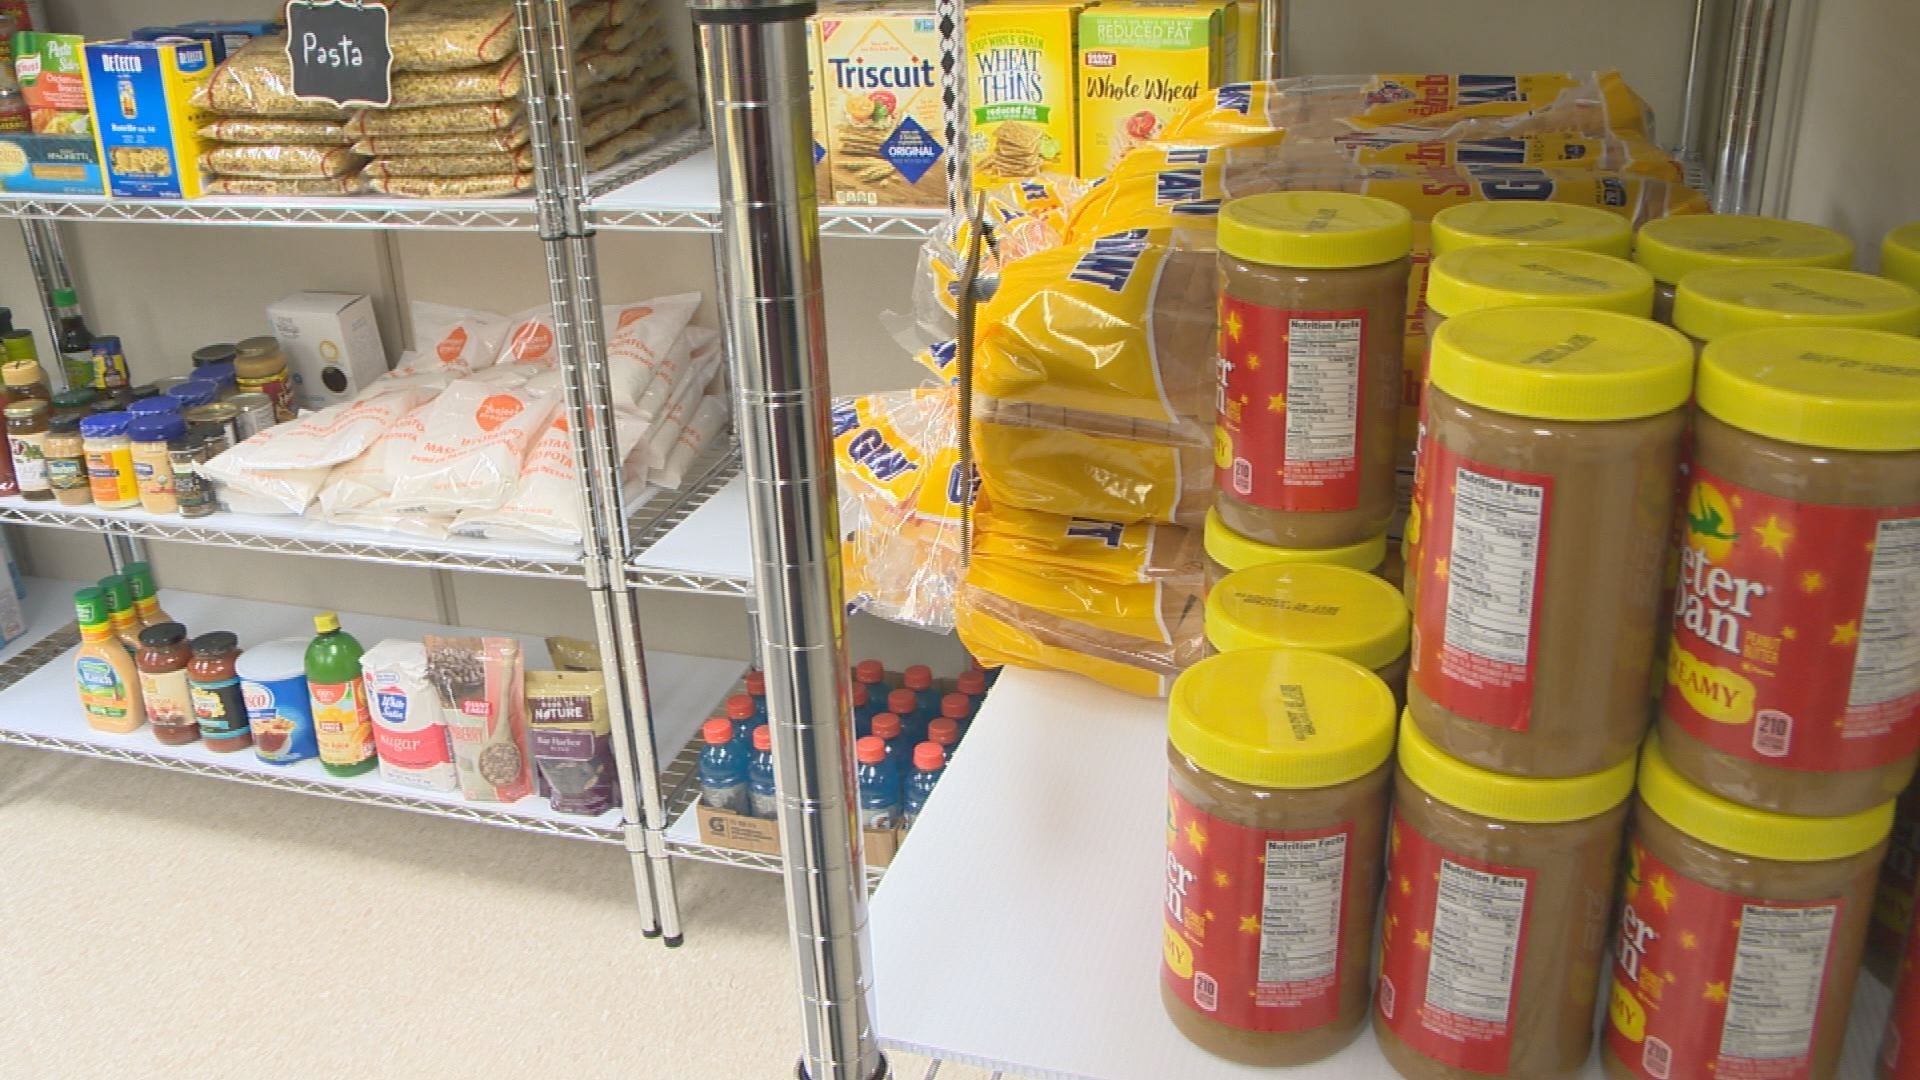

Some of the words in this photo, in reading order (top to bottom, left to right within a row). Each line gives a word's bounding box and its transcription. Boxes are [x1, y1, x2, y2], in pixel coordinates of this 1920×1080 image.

[1097, 24, 1163, 39] REDUCED
[1167, 25, 1193, 40] FAT
[303, 32, 363, 67] Pasta
[976, 48, 1042, 73] WHEAT
[828, 58, 935, 88] Triscuit
[1087, 73, 1140, 101] Whole
[1145, 78, 1200, 103] Wheat
[888, 146, 935, 157] ORIGINAL
[1292, 321, 1333, 330] Nutrition
[1335, 320, 1360, 329] Facts
[1458, 470, 1503, 491] Nutrition
[1505, 483, 1540, 498] Facts
[1759, 715, 1788, 736] 210
[381, 736, 421, 752] sugar
[1268, 842, 1316, 851] Nutrition
[1319, 836, 1345, 847] Facts
[1443, 861, 1490, 883] Nutrition
[1492, 876, 1525, 888] Facts
[1746, 906, 1800, 918] Nutrition
[1197, 975, 1216, 997] 210
